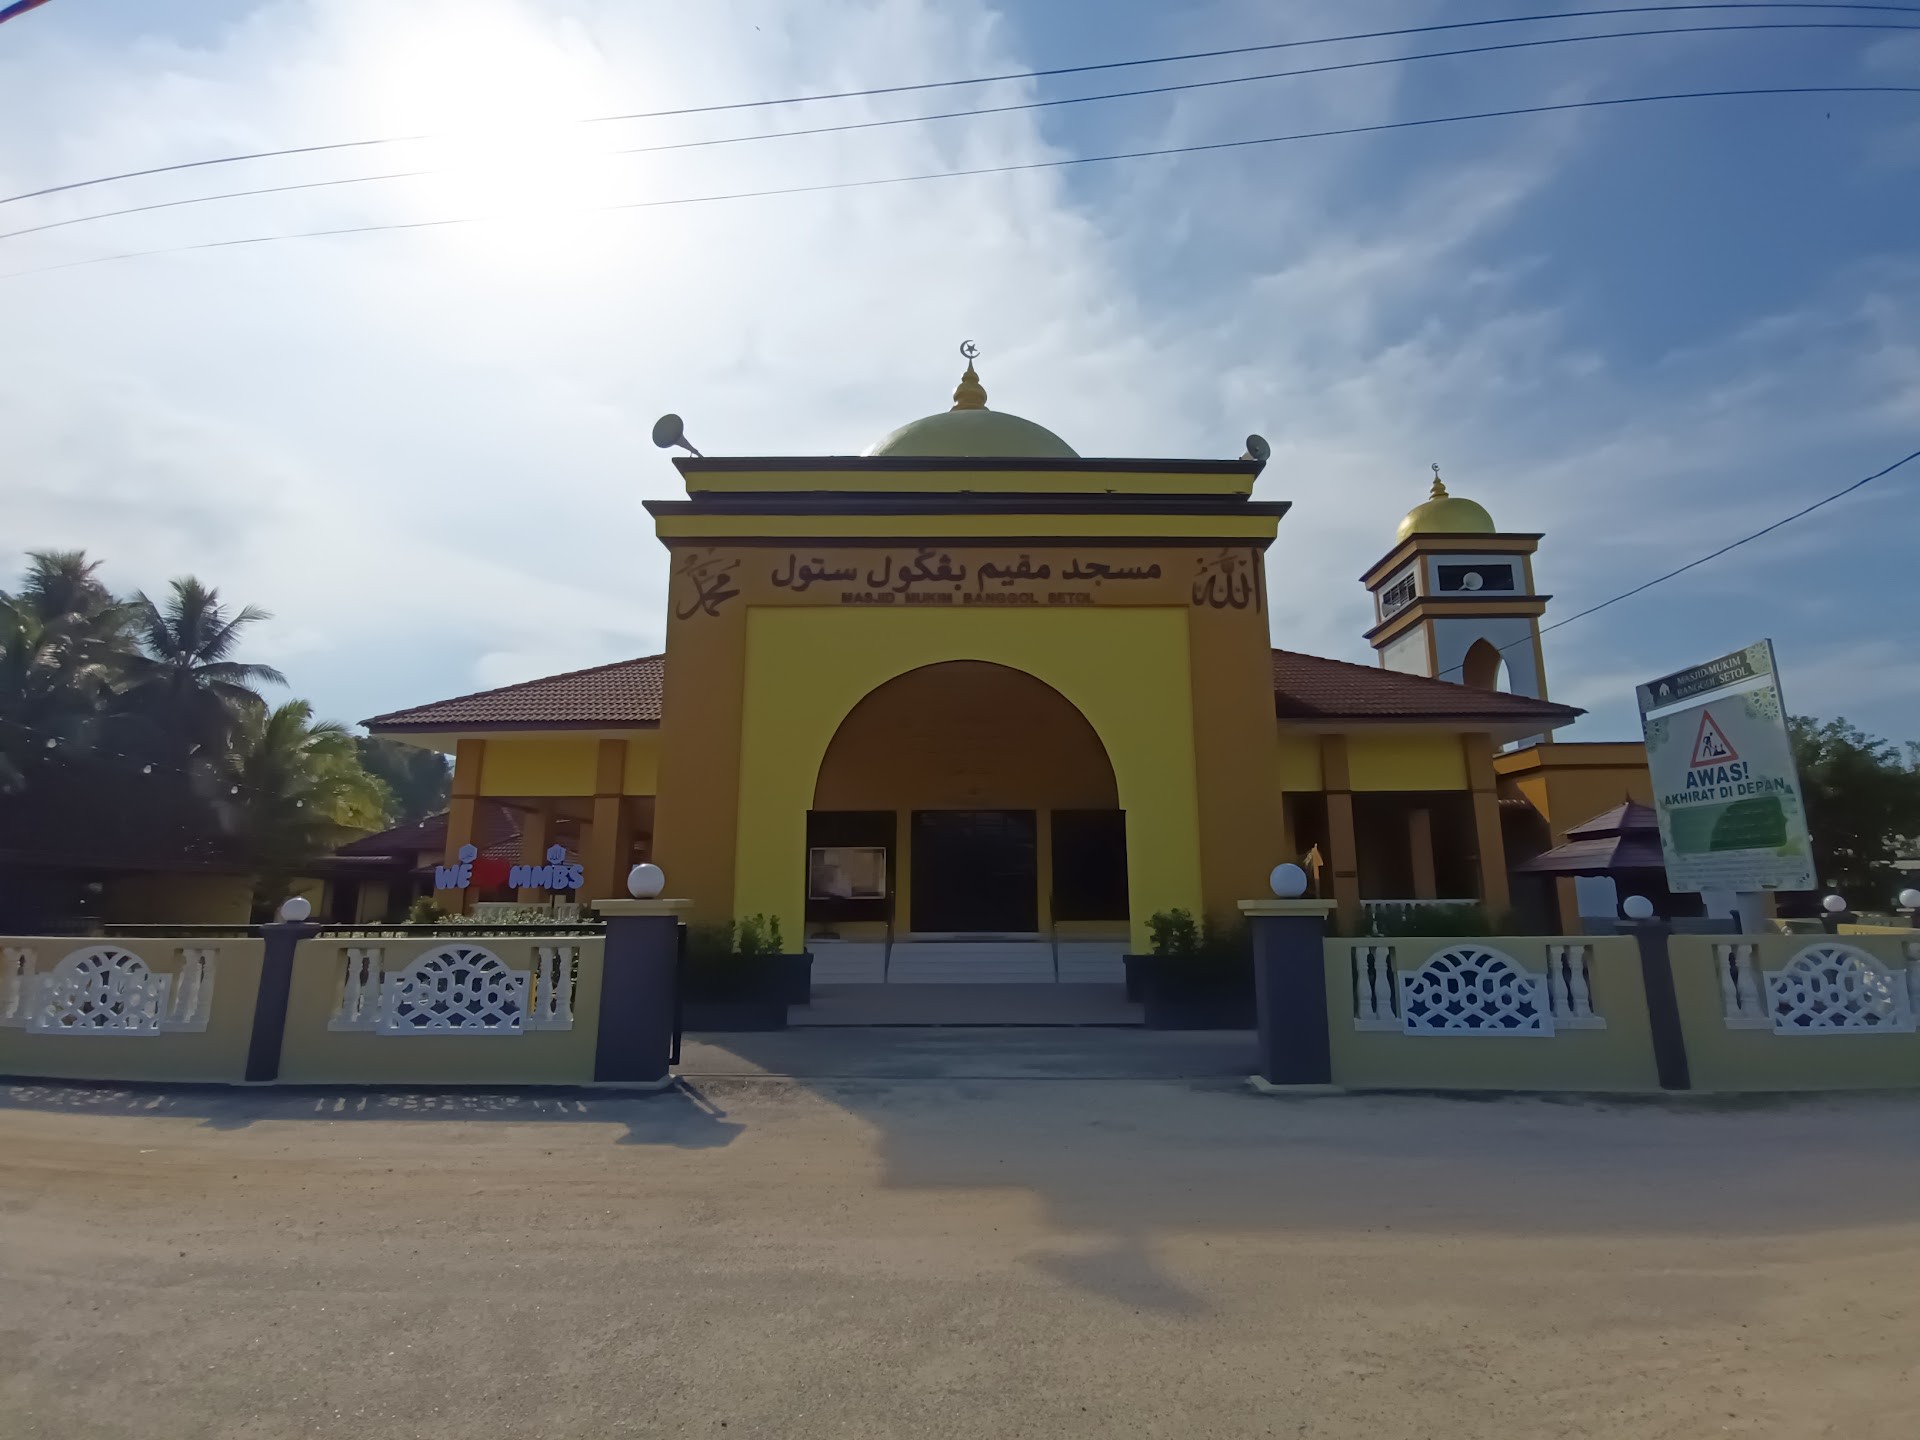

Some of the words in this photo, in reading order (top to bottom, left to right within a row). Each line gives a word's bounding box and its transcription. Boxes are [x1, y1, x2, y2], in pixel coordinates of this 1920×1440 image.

[771, 553, 858, 592] ستول
[1062, 558, 1161, 587] مسجد
[841, 592, 895, 603] MASJID
[905, 592, 953, 603] MUKIM
[963, 592, 1038, 603] BANGGOL
[1048, 592, 1094, 603] SETOL
[1708, 656, 1741, 674] MUKIM
[1719, 666, 1748, 684] SETOL
[1686, 761, 1749, 789] AWAS!
[1665, 788, 1715, 805] AKHIRAT
[1720, 787, 1733, 798] DI
[1737, 777, 1785, 795] DEPAN
[435, 864, 473, 889] WE
[509, 865, 584, 889] MMBS
